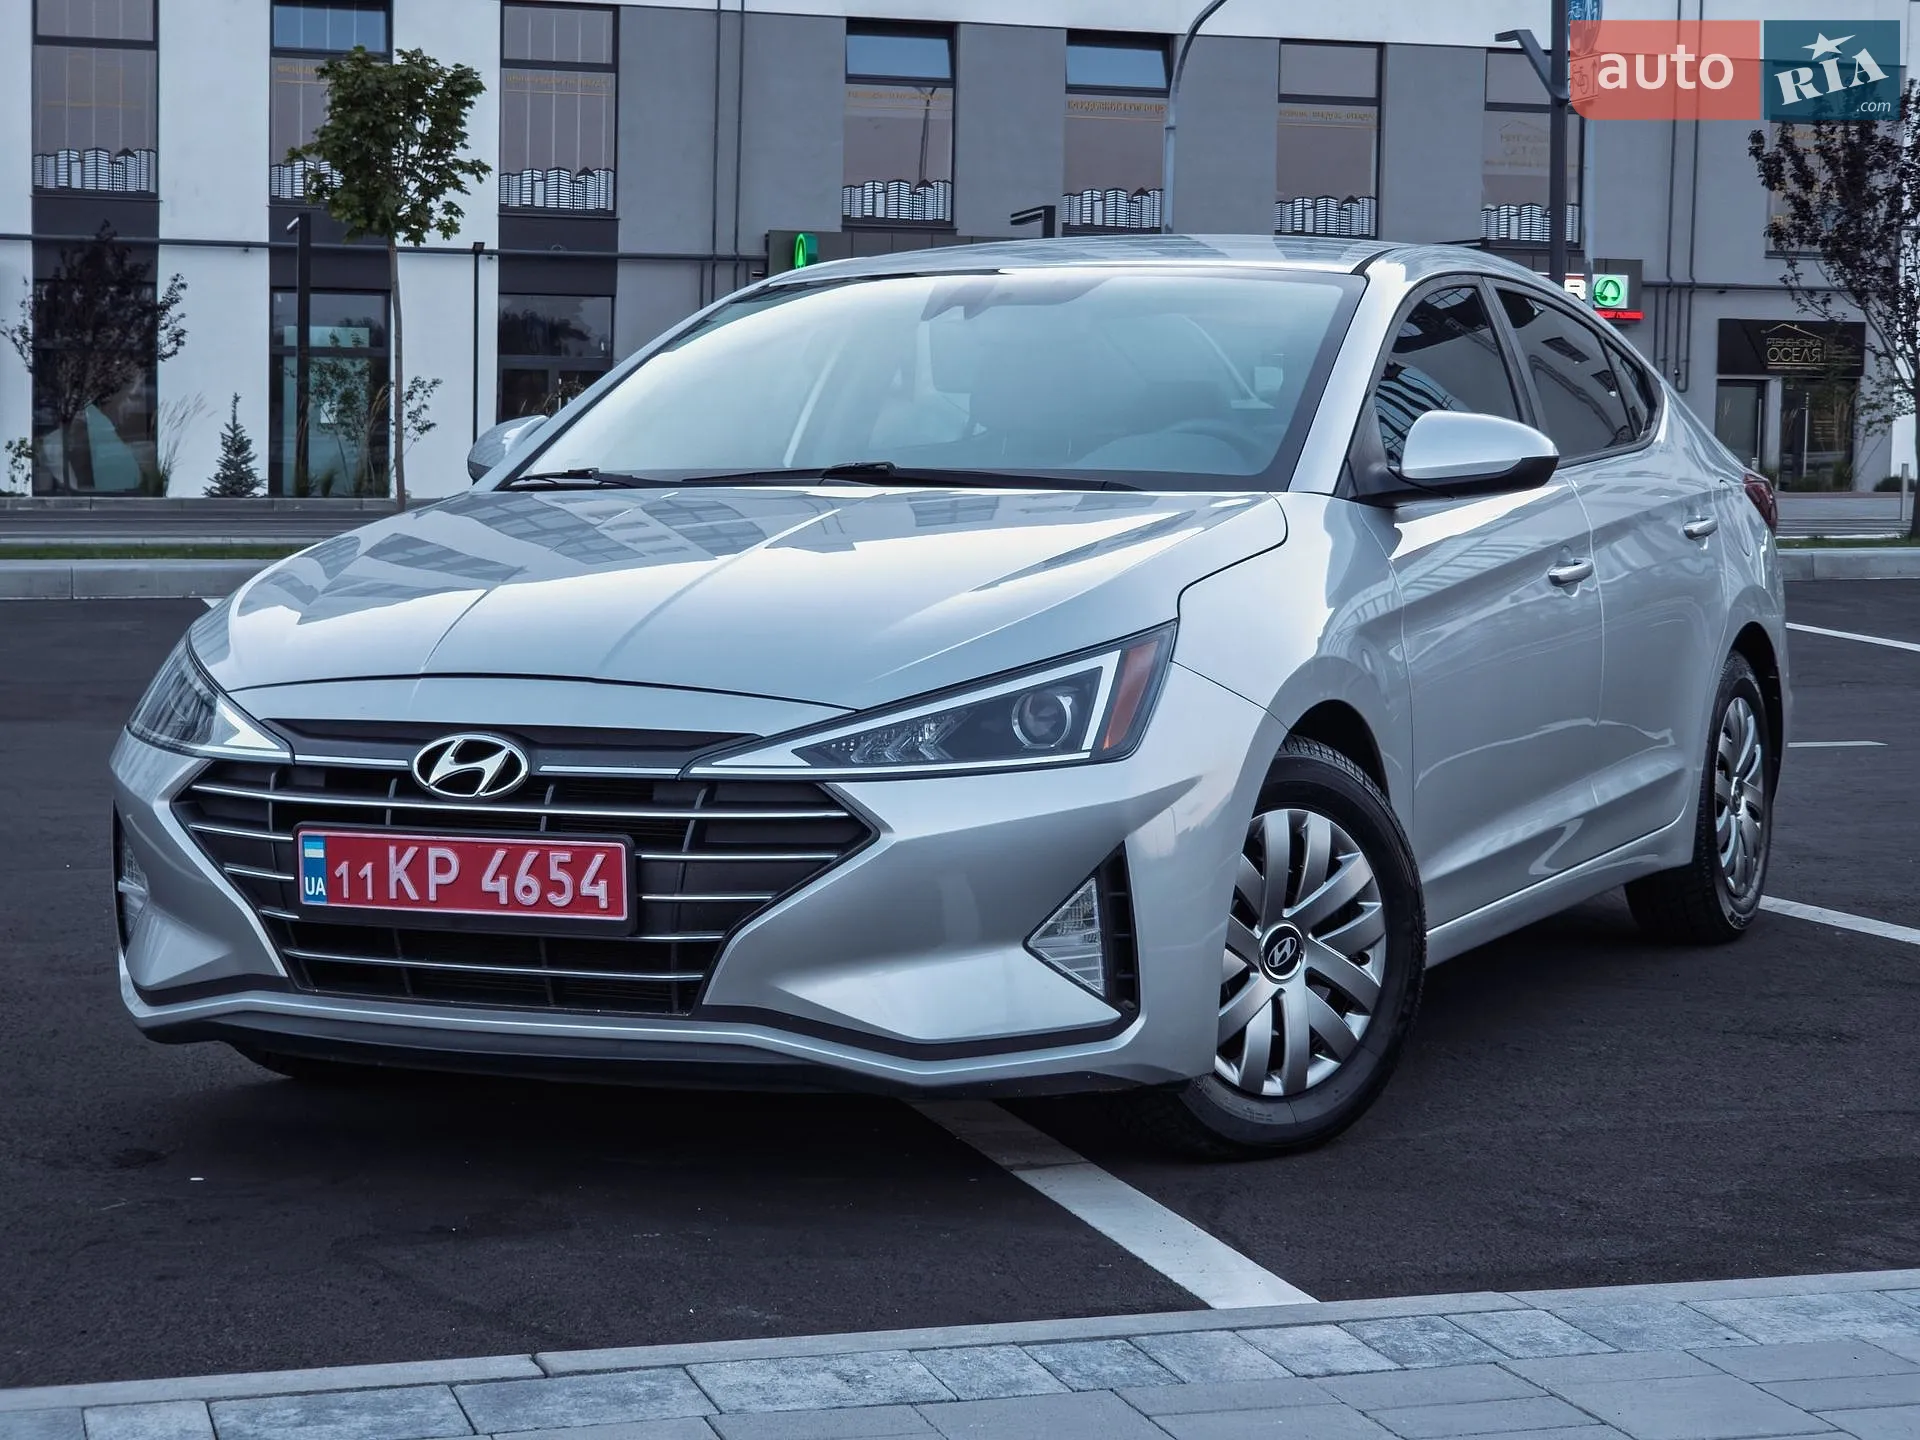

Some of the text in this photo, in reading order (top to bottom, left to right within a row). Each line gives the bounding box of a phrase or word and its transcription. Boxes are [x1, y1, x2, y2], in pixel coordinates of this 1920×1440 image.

[1766, 347, 1822, 362] ОСЕЛЯ
[304, 876, 327, 896] UA
[481, 850, 609, 910] 4654
